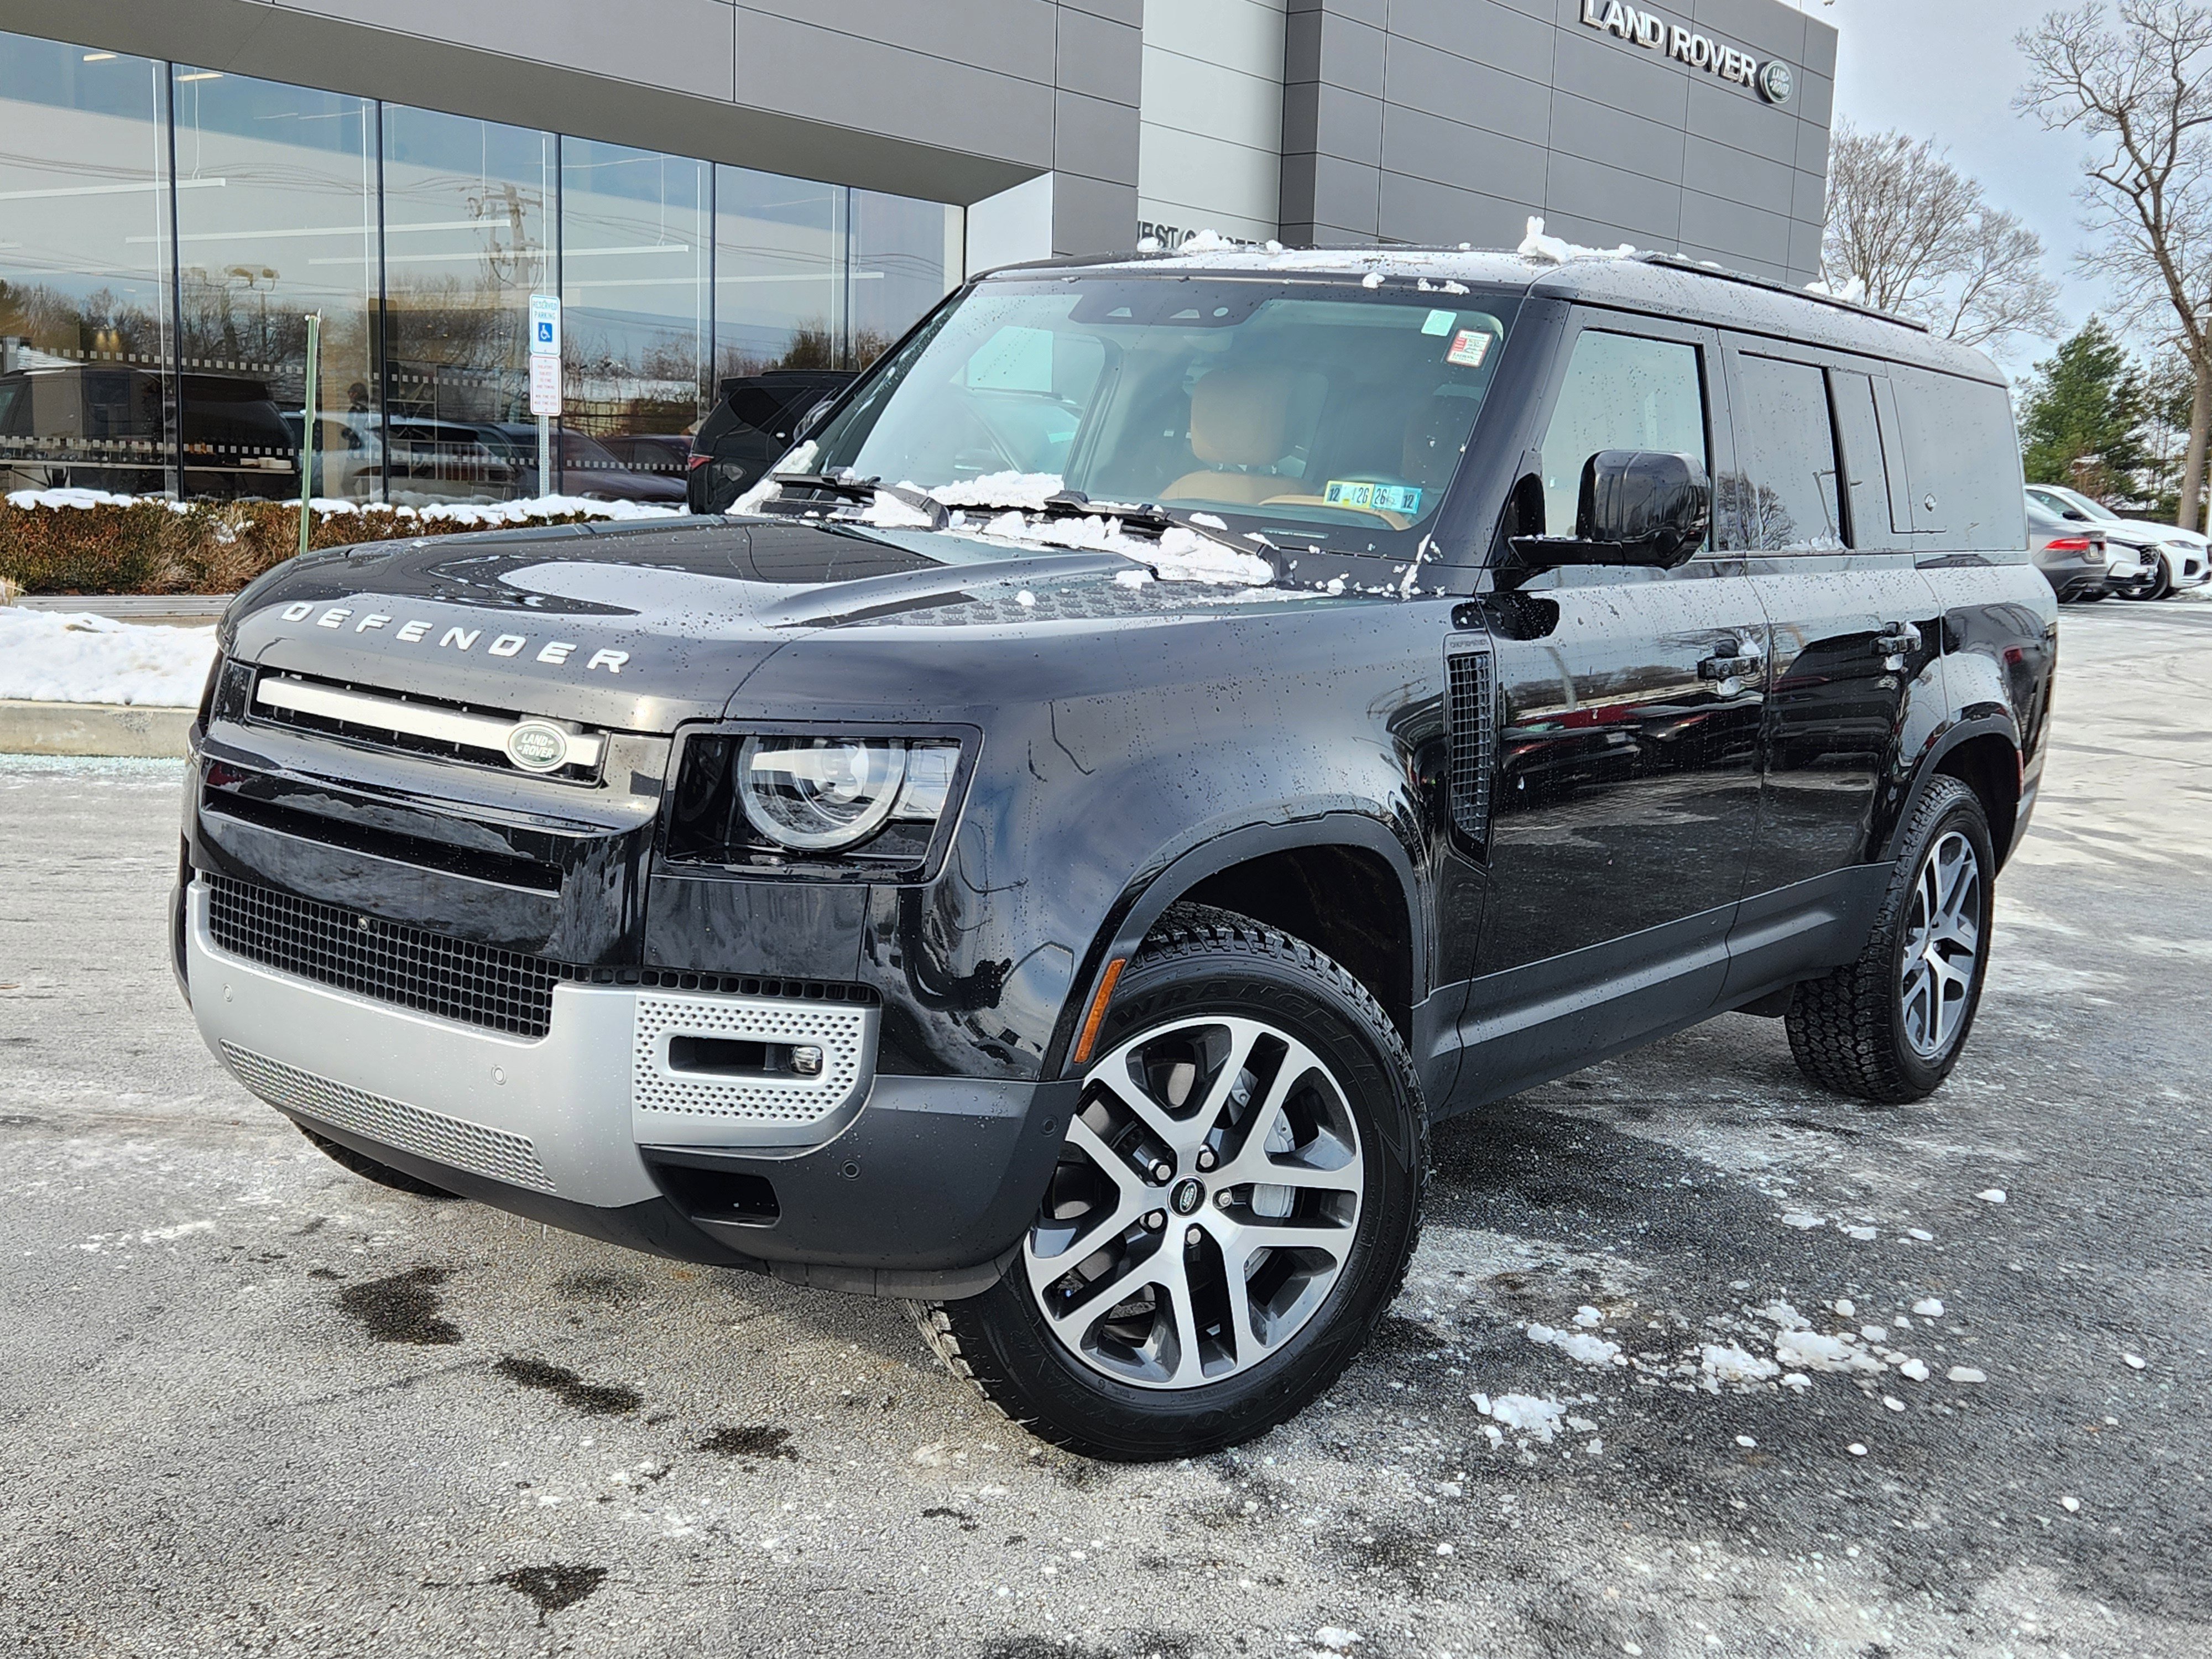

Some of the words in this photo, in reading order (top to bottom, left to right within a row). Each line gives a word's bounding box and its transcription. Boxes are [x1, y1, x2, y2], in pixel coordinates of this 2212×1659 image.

[1583, 0, 1664, 48] LAND
[1669, 25, 1757, 87] ROVER
[1138, 221, 1178, 249] EST
[1329, 488, 1340, 502] 12
[1357, 487, 1369, 504] 26
[1374, 488, 1387, 504] 26
[1404, 495, 1415, 509] 12
[281, 602, 629, 673] DEFENDER
[521, 733, 548, 746] LAND
[521, 744, 554, 758] ROVER
[1112, 980, 1384, 1091] WRANGLER
